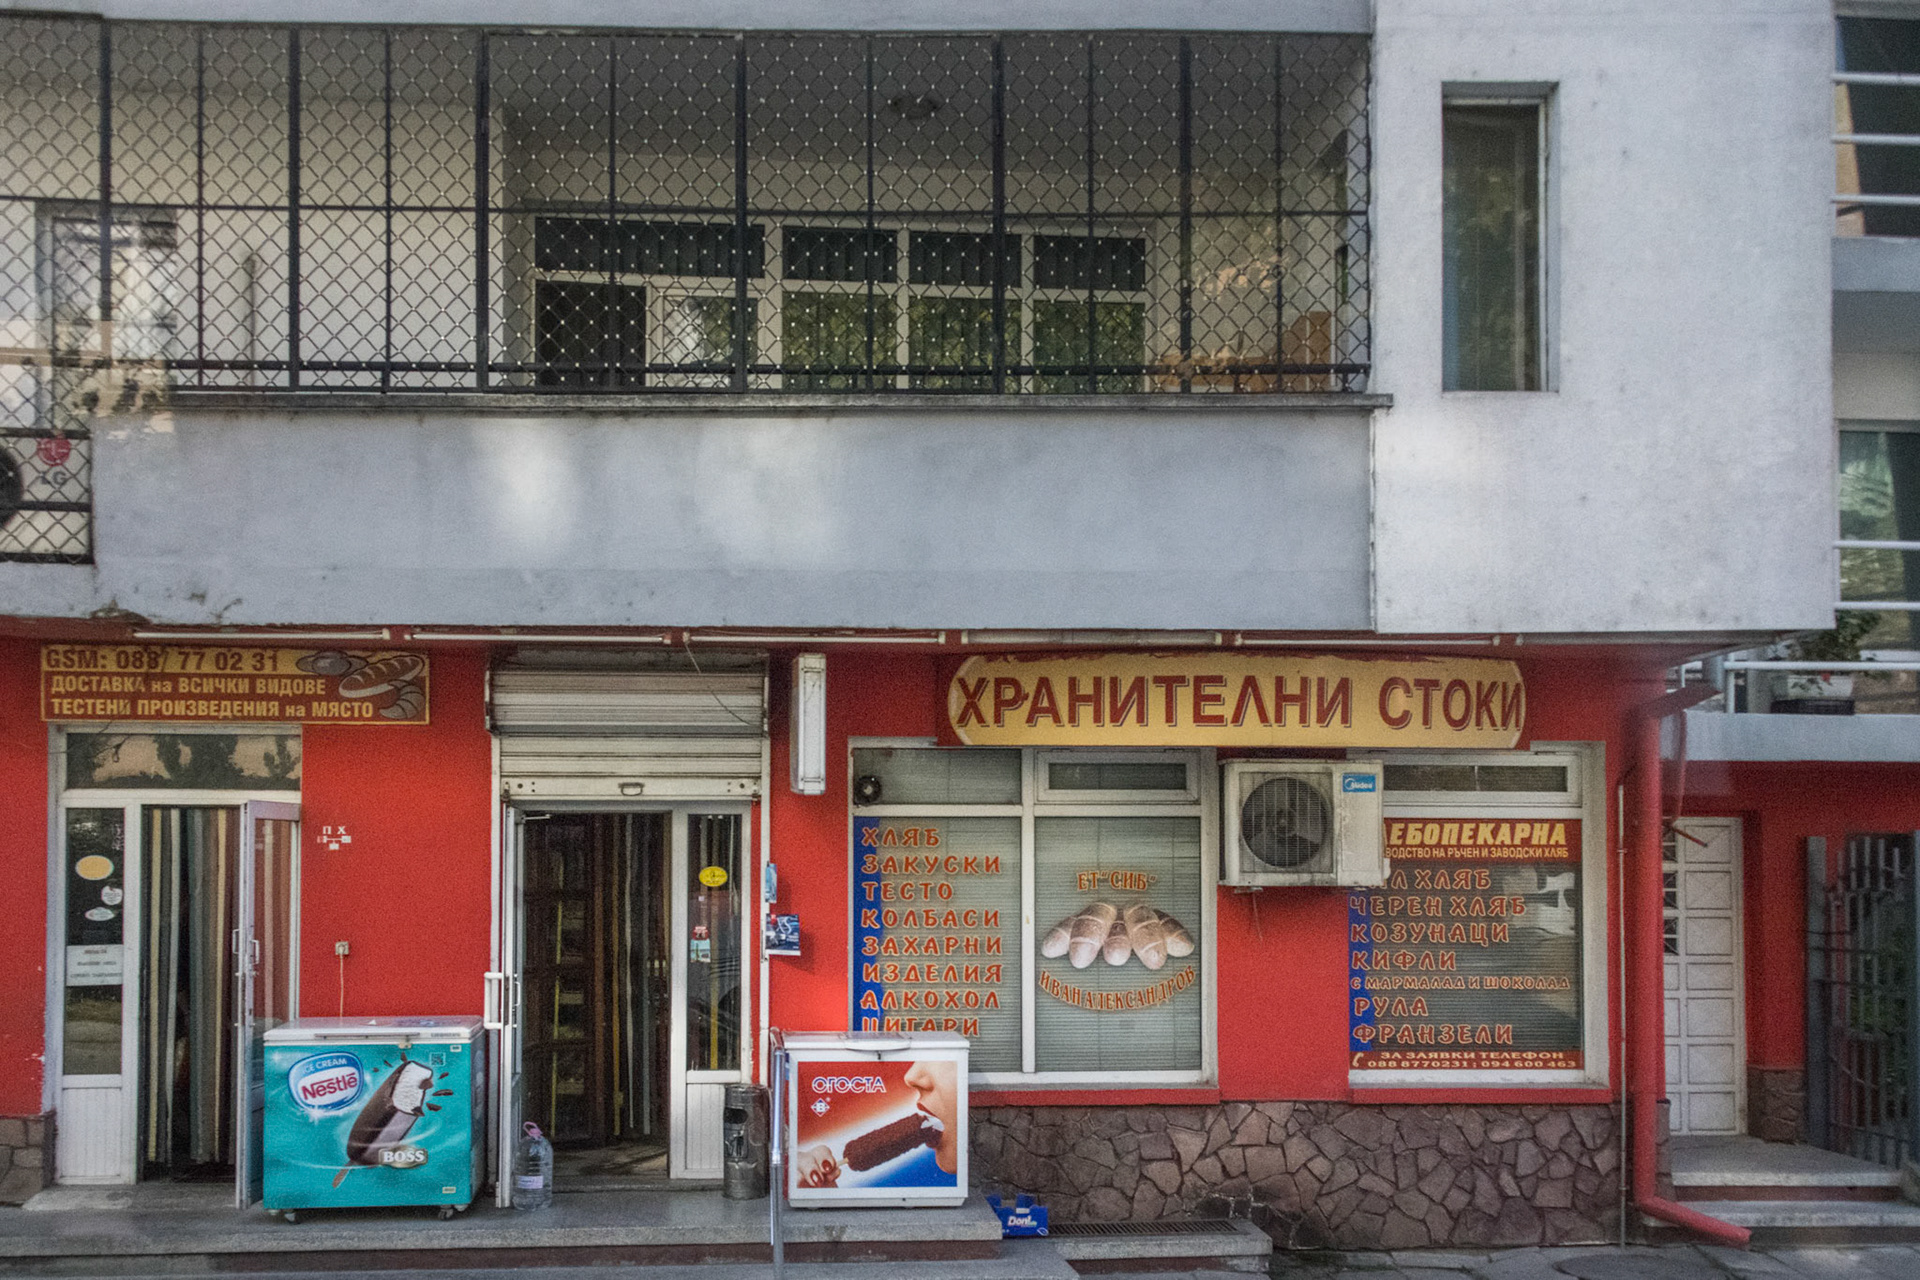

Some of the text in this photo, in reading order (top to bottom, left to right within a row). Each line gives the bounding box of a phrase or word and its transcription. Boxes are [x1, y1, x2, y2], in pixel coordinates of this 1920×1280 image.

[46, 650, 106, 669] GSM:
[178, 651, 206, 670] 77
[215, 652, 243, 671] 02
[252, 652, 278, 671] 31
[51, 676, 326, 696] ДОСТАВКА на ВСИЧКИ ВИДОВЕ
[51, 699, 374, 719] ТЕСТЕНИ ПРОИЗВЕДЕНИЯ на МЯСТО
[957, 675, 1522, 731] ХРАНИТЕЛНИ СТОКИ
[861, 827, 940, 847] ХЛЯБ
[1384, 822, 1567, 846] ЕБОПЕКАРНА
[1432, 847, 1446, 858] НА
[1447, 847, 1480, 858] РЪЧЕН
[1481, 847, 1488, 858] И
[1490, 847, 1542, 859] ЗАВОДСКИ
[1544, 847, 1569, 858] ХЛЯБ
[861, 855, 1001, 874] ЗАКУСКИ
[1414, 869, 1491, 889] ХЛЯБ
[862, 881, 953, 901] ТЕСТО
[1350, 896, 1526, 916] ЧЕРЕН ХЛЯБ
[861, 909, 1000, 929] КОЛБАСИ
[1351, 923, 1509, 947] КОЗУНАЦИ
[861, 936, 1002, 956] ЗАХАРНИ
[1352, 950, 1456, 970] КИФЛИ
[863, 963, 1002, 983] ИЗДЕЛИЯ
[1365, 976, 1465, 989] МАРМАЛАД
[1468, 976, 1480, 989] И
[1483, 976, 1570, 989] ШОКОЛАД
[1039, 970, 1082, 1007] ИВАН
[860, 990, 1000, 1009] АЛКОХОЛ
[1354, 997, 1428, 1016] РУЛА
[1353, 1024, 1513, 1044] ФРАНЗЕЛИ
[316, 1058, 347, 1069] CREAM
[812, 1076, 887, 1093] ОГОСТА
[384, 1150, 425, 1162] BOSS
